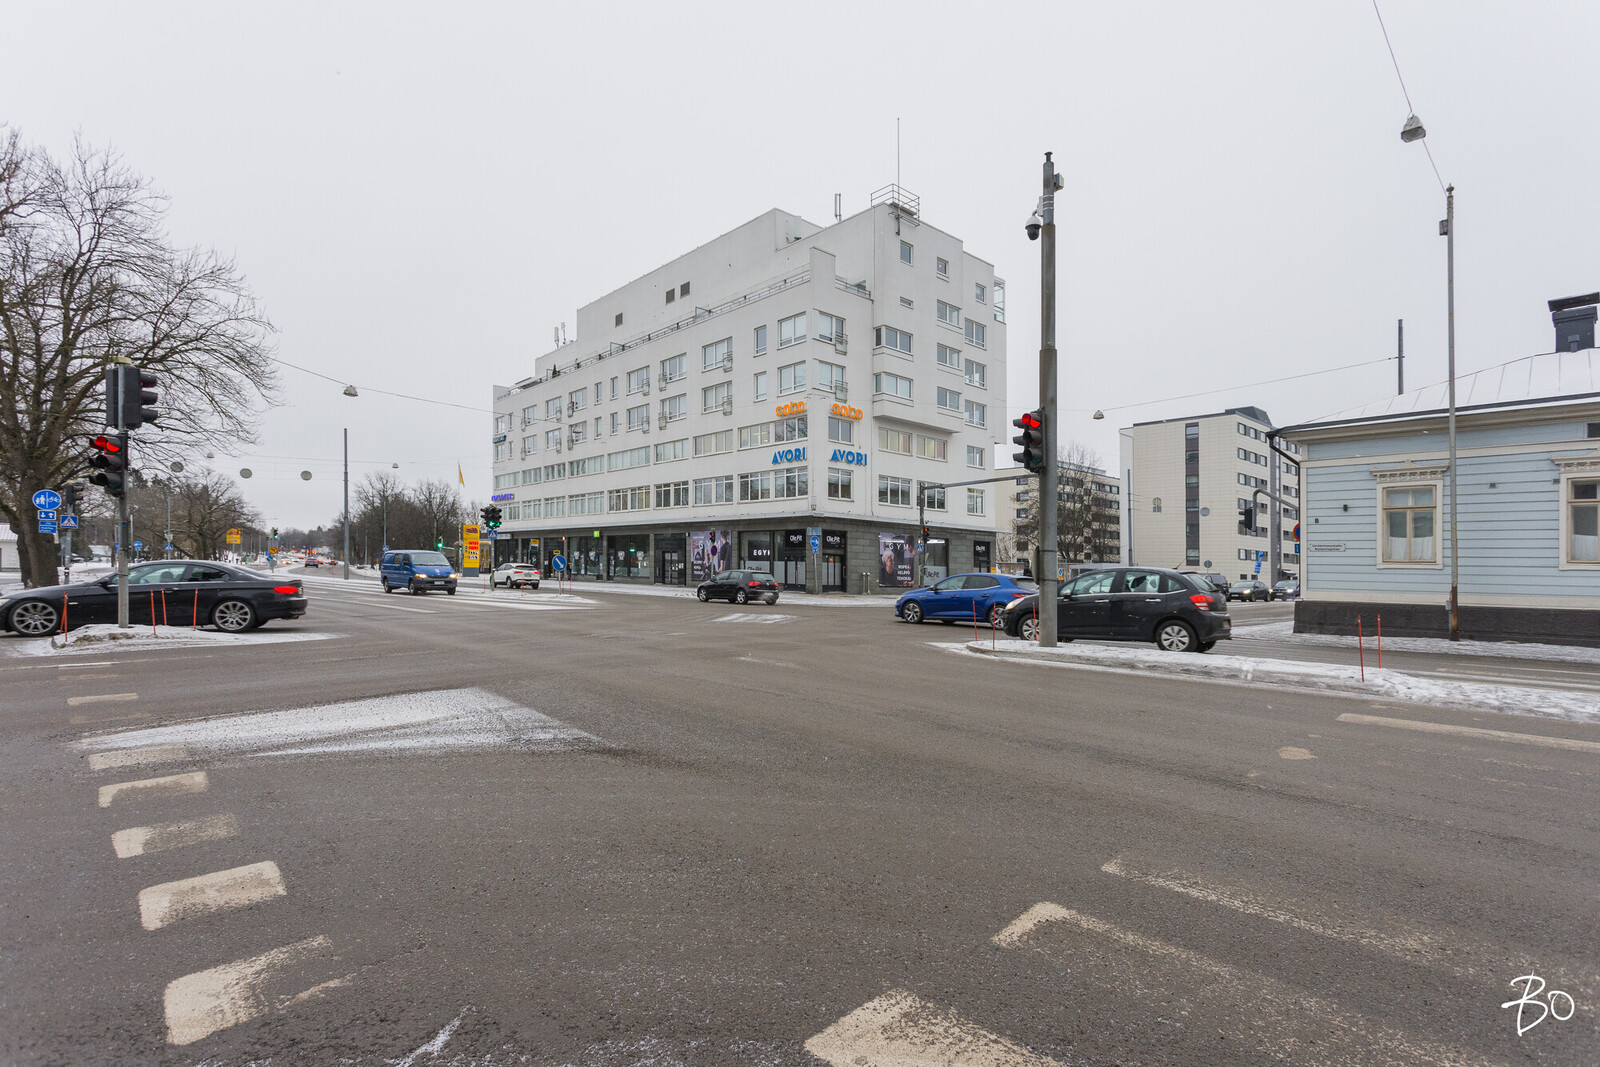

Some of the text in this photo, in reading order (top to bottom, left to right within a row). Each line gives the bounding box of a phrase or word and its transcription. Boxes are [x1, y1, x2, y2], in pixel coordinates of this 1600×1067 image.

[776, 401, 804, 416] sato
[832, 403, 864, 420] sato
[771, 447, 806, 464] AVORI
[830, 449, 867, 466] AVORI
